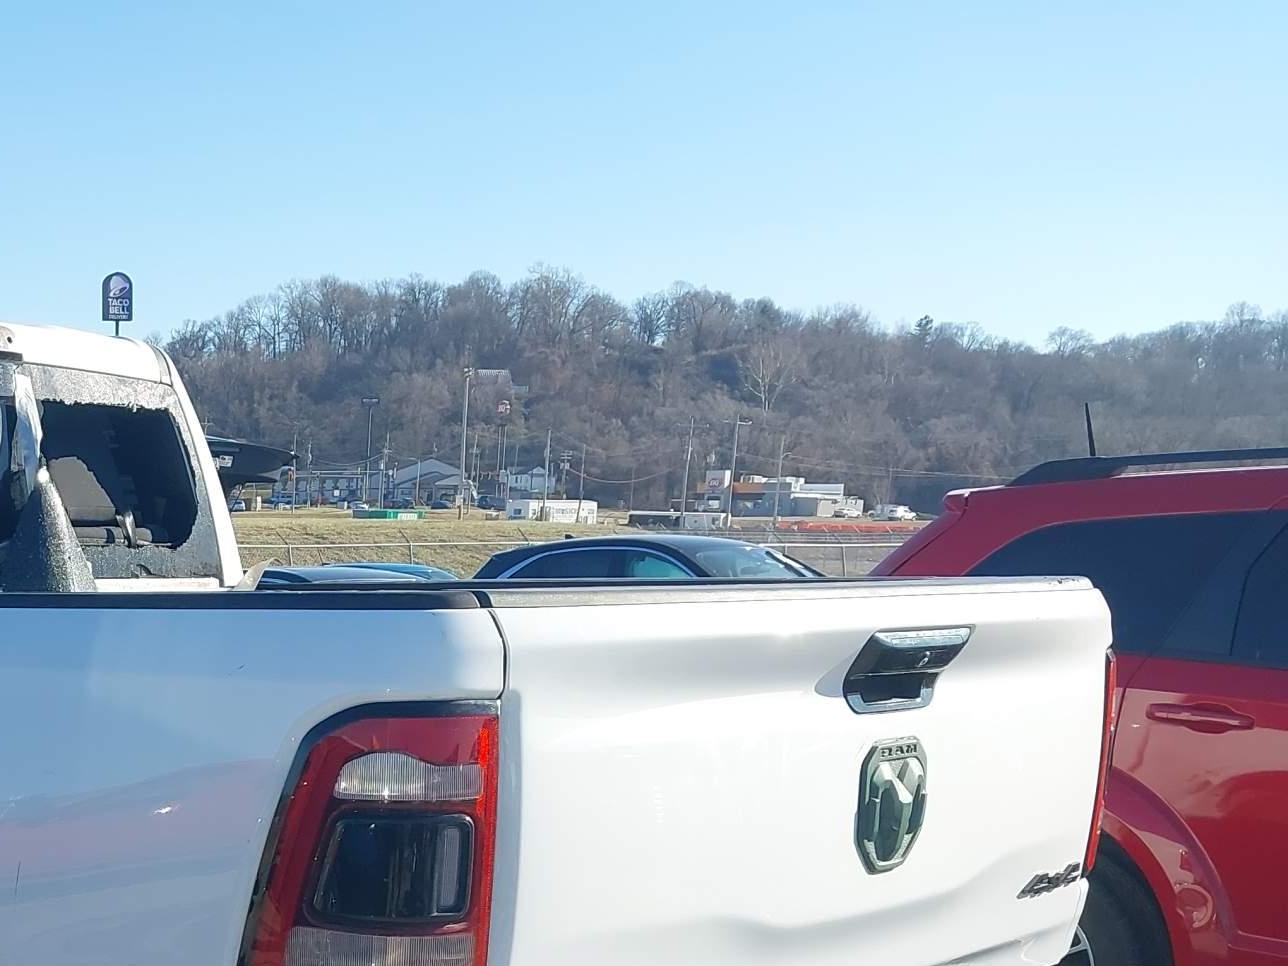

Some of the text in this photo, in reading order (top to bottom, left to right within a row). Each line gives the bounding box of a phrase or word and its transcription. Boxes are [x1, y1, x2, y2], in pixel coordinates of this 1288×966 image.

[108, 298, 130, 306] TACO
[109, 306, 130, 314] BELL
[879, 743, 918, 758] RAM
